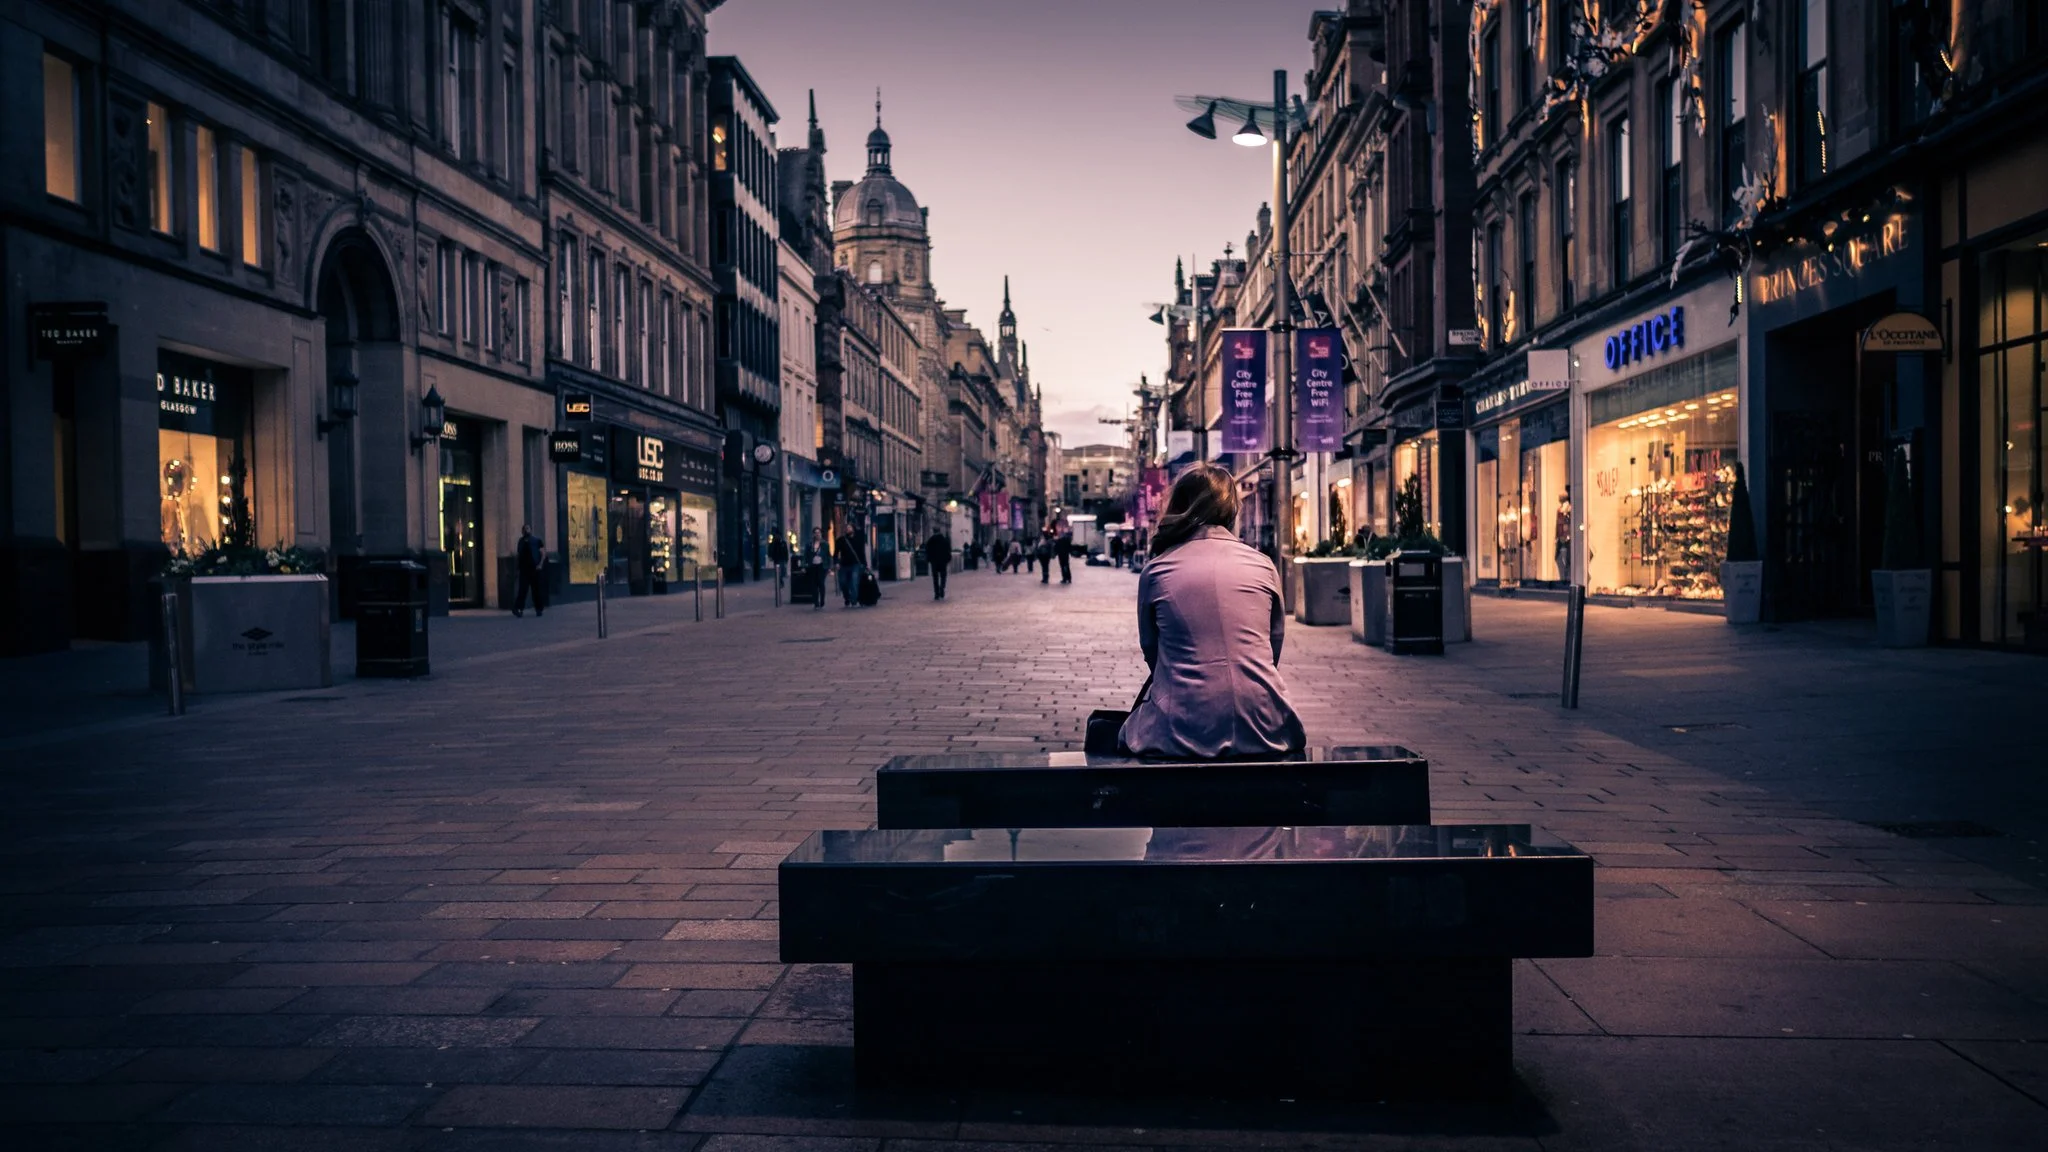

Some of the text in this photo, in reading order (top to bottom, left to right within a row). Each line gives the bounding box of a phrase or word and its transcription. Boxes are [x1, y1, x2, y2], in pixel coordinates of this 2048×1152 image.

[1760, 213, 1910, 304] PRINCES SQUARE
[65, 328, 98, 339] BAKER
[1604, 306, 1684, 370] OFFICE
[1870, 329, 1937, 340] L'OCCITANE
[1236, 370, 1253, 380] City
[1312, 369, 1328, 380] City
[156, 372, 217, 402] D BAKER
[1231, 381, 1257, 389] Centre
[1306, 380, 1333, 388] Centre
[1235, 390, 1253, 399] Free
[1311, 390, 1329, 398] Free
[160, 399, 198, 415] GLASGOW
[566, 402, 590, 413] USC
[1235, 399, 1253, 408] WiFi
[1311, 398, 1329, 407] WiFi
[1476, 390, 1509, 414] CHARLES
[442, 421, 458, 437] OSS
[554, 441, 579, 449] BOSS
[637, 435, 664, 469] USC
